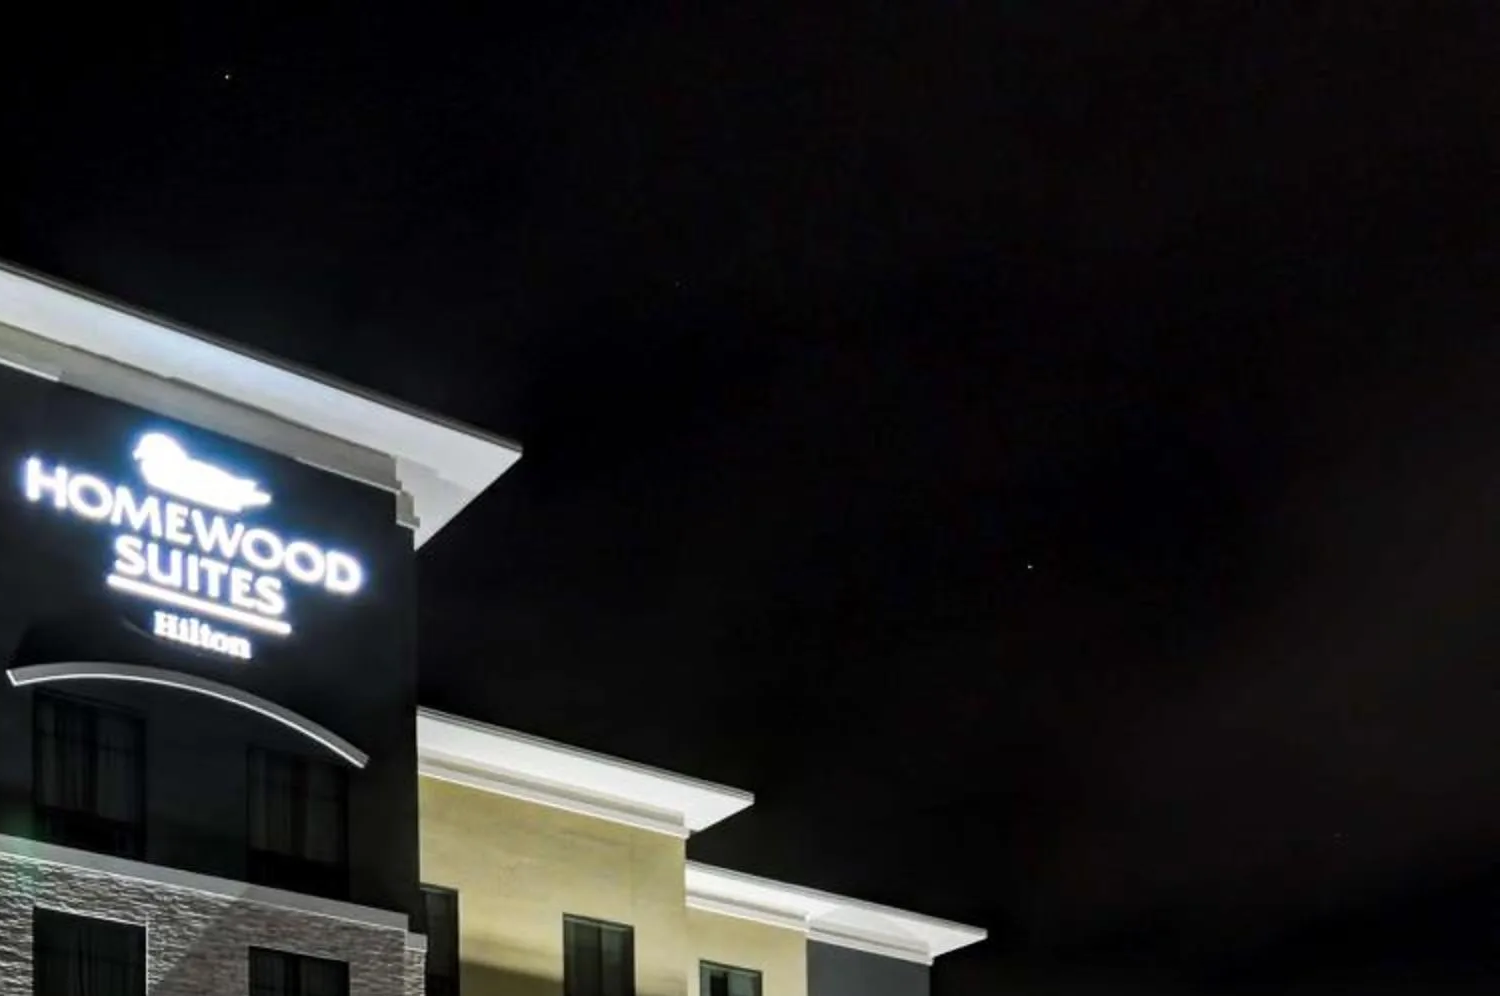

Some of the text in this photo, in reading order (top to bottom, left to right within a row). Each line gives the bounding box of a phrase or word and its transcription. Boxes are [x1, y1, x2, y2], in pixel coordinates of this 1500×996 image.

[23, 456, 364, 594] HOMEWOOD
[114, 534, 287, 616] SUITES
[152, 610, 253, 660] Hilton
